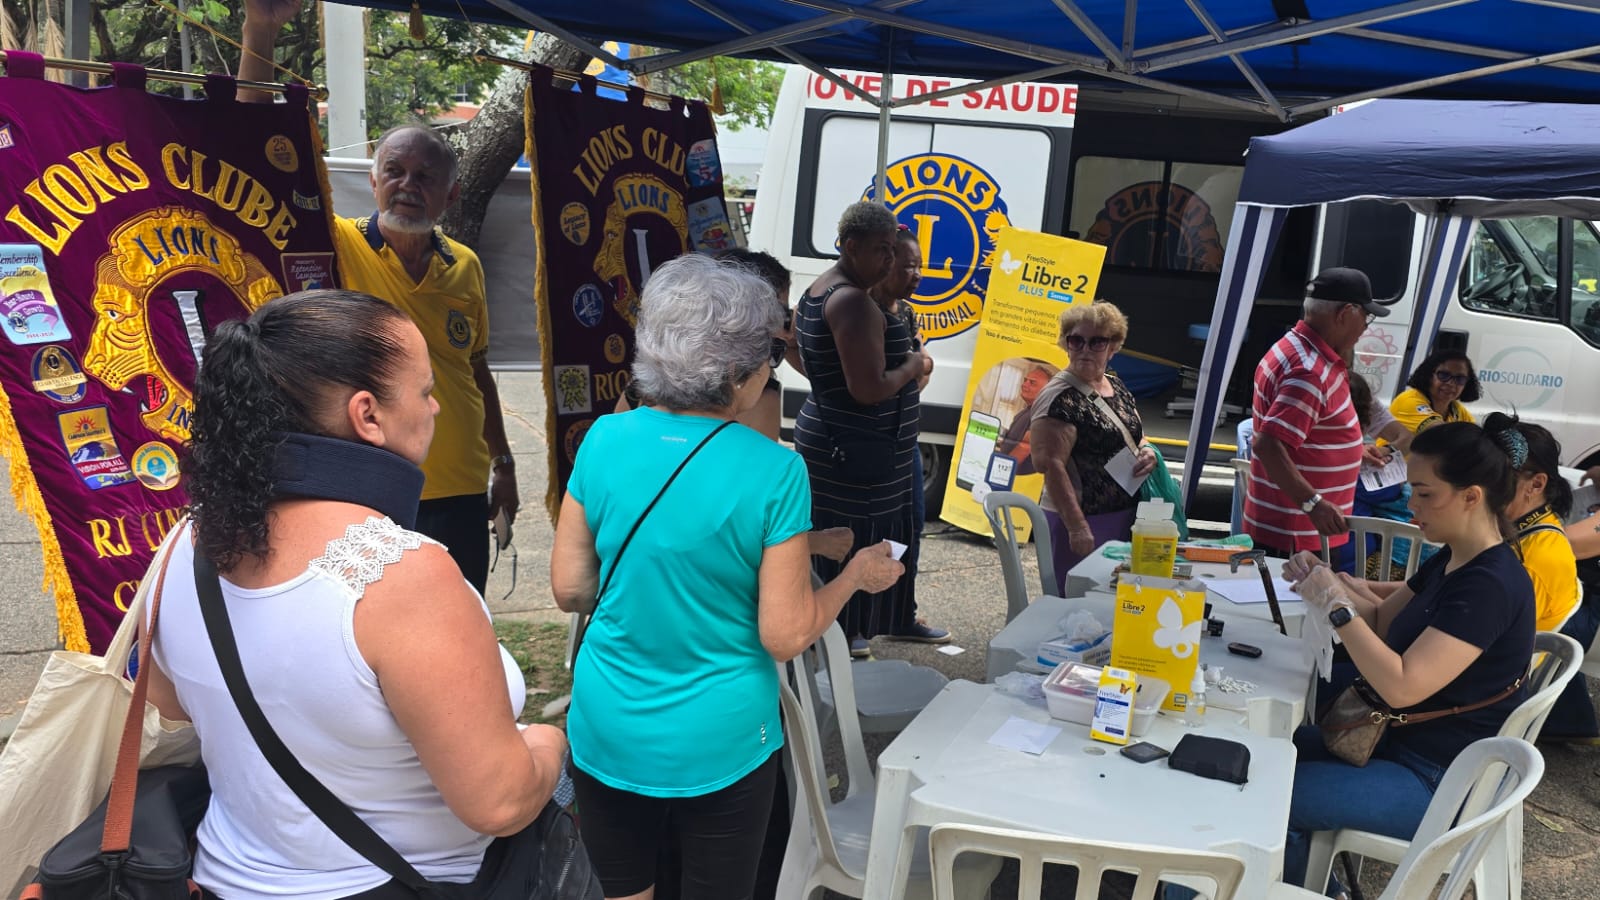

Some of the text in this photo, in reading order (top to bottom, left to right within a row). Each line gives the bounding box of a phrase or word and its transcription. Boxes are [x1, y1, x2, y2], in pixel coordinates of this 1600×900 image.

[808, 72, 897, 102] OVE
[906, 79, 951, 108] DE
[273, 137, 287, 152] 25
[573, 125, 686, 197] LIONS CLU
[886, 160, 990, 205] LIONS
[5, 141, 297, 256] LIONS CLUBE
[617, 183, 671, 215] LIONS
[135, 226, 221, 265] LIONS
[913, 213, 953, 279] L
[1026, 254, 1056, 266] FreeStyle
[1018, 284, 1044, 297] PLUS
[1021, 263, 1088, 294] Libre 2
[915, 302, 976, 331] ATIONAL
[1478, 369, 1563, 388] RIOSOLIDARIO
[166, 402, 192, 430] IN
[78, 463, 99, 474] VISION
[112, 458, 125, 467] ALL
[86, 506, 187, 558] RJ LIN
[1519, 511, 1541, 530] ASIL
[1122, 602, 1140, 611] Libre
